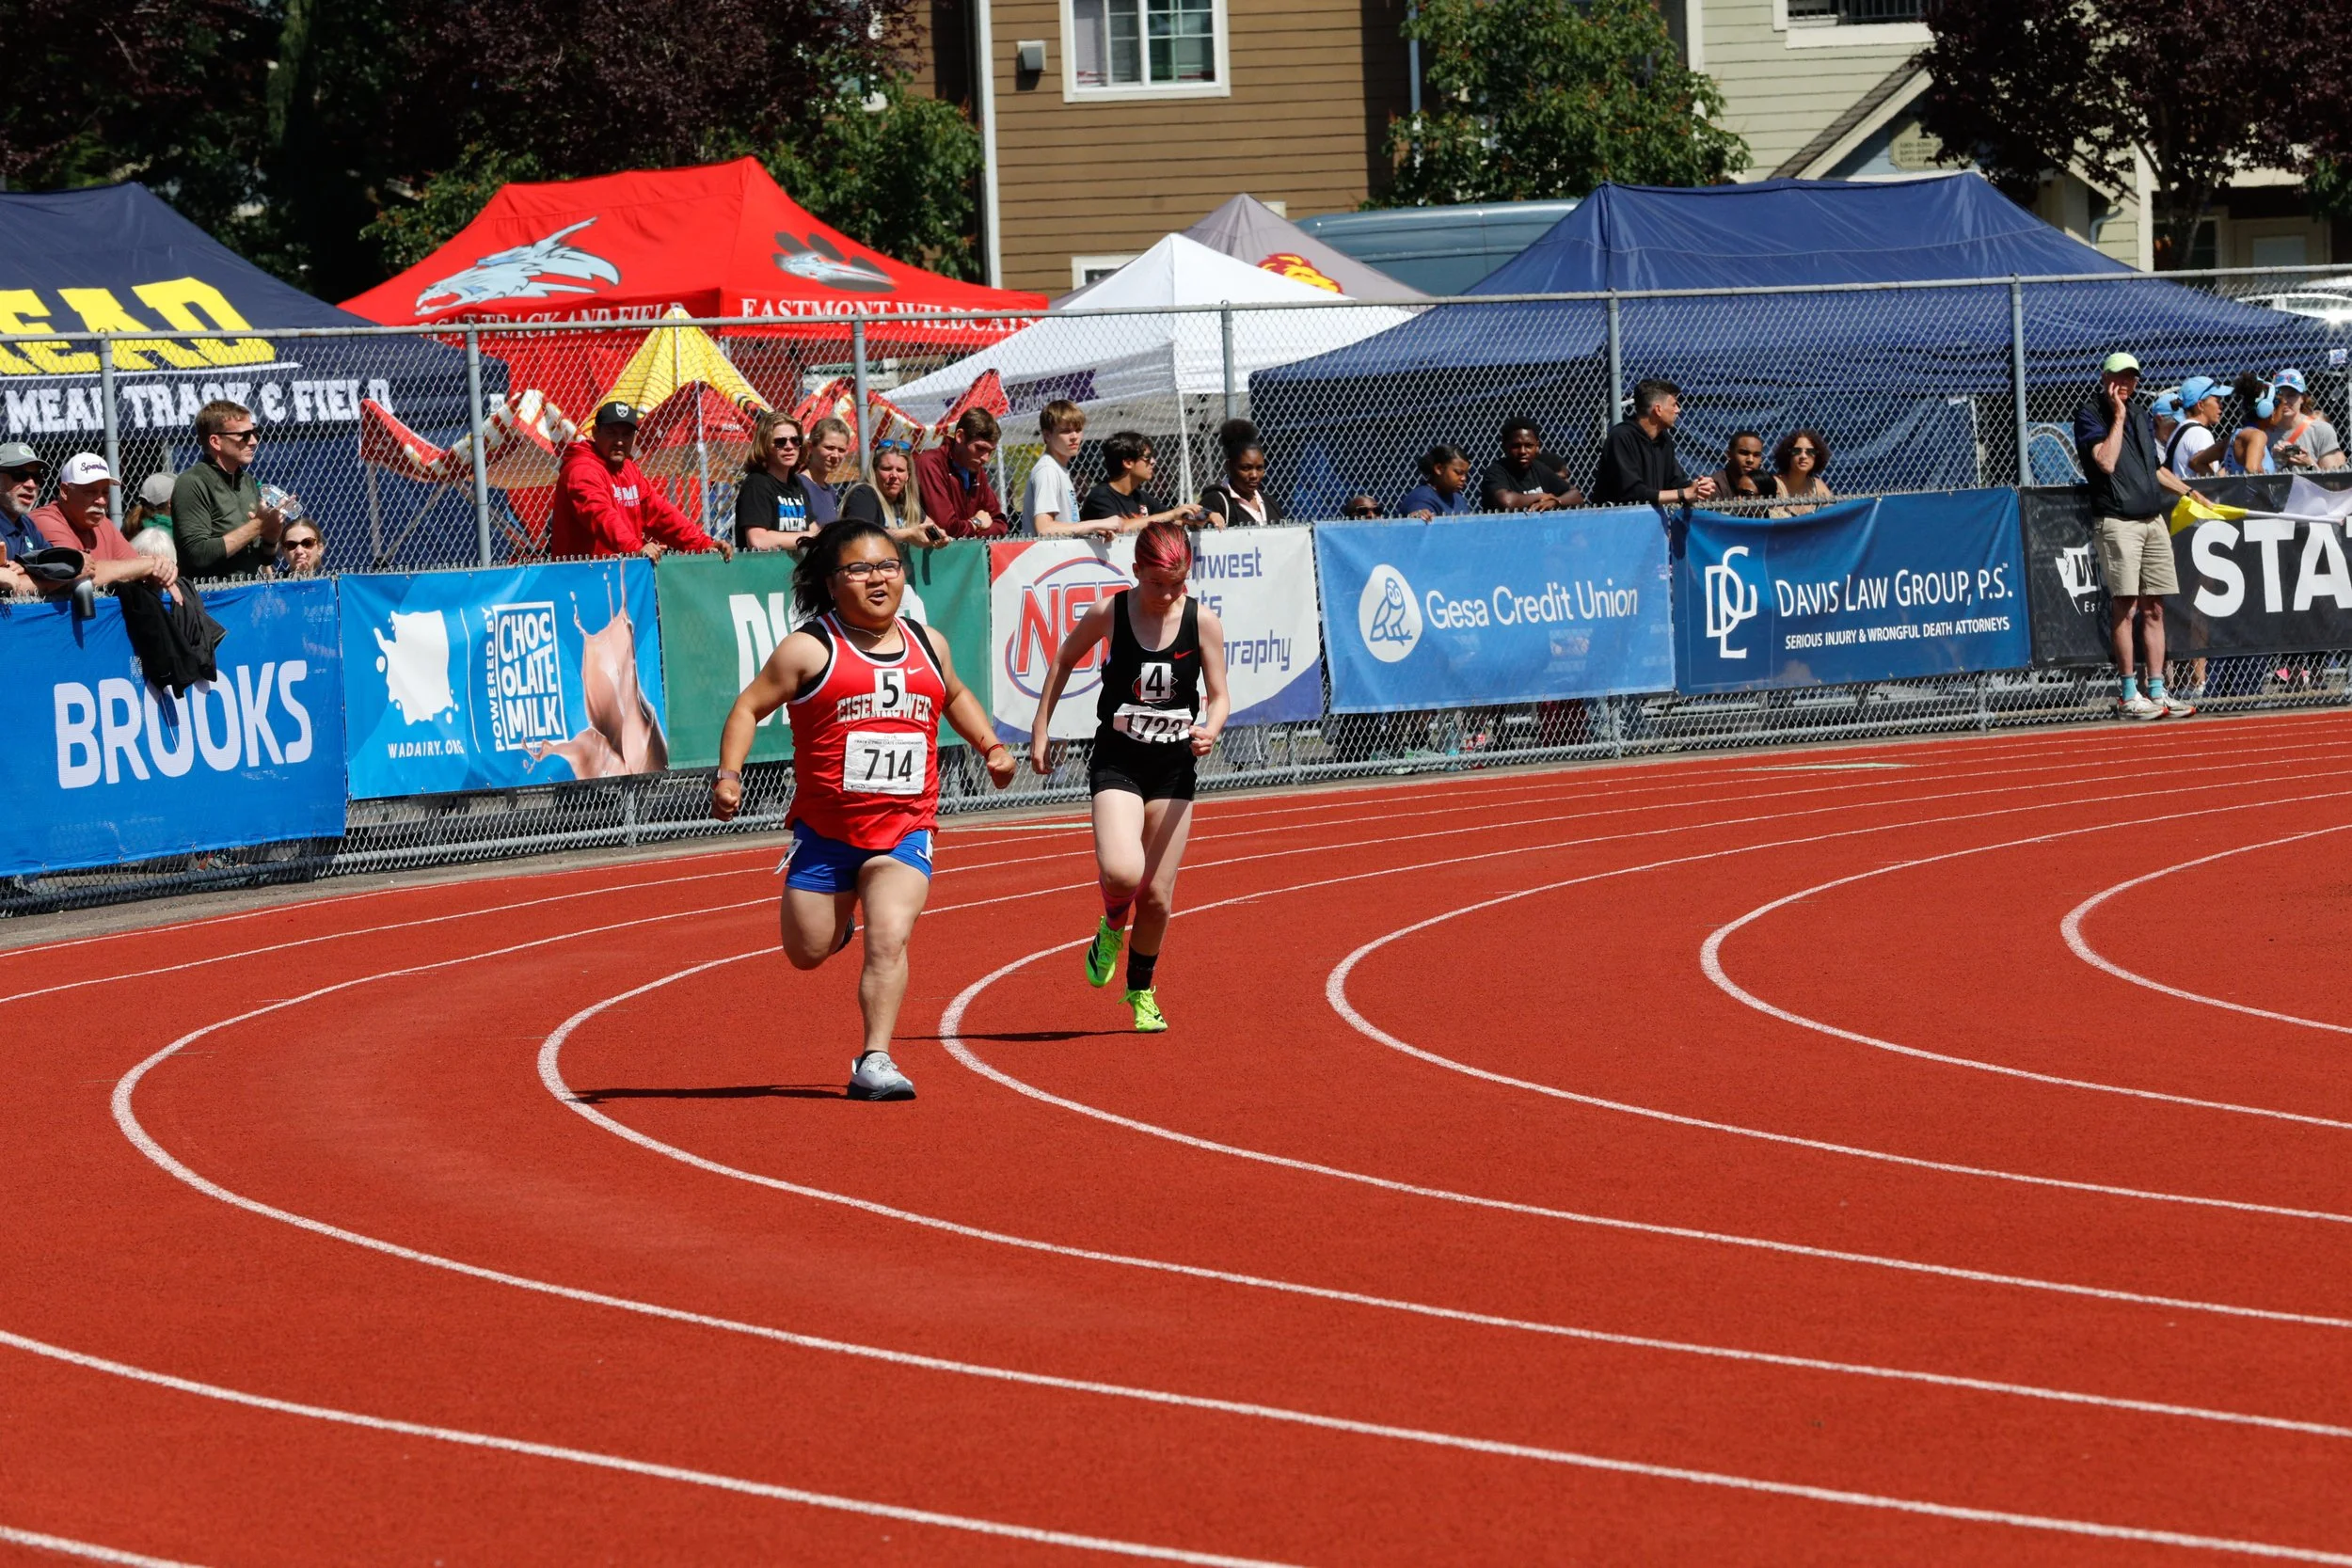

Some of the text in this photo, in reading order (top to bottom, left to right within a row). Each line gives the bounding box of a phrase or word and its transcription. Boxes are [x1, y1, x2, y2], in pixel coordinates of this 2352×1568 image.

[0, 277, 275, 374] EAD
[482, 311, 562, 340] TRACK
[564, 307, 611, 335] AND
[740, 298, 1035, 333] EASTMONT WILDCATS
[1191, 546, 1263, 579] hwest
[2191, 515, 2352, 618] STA
[1425, 578, 1637, 629] Gesa Credit Union
[1775, 579, 1839, 617] DAVIS
[1845, 574, 1888, 611] LAW
[1895, 569, 1972, 607] GROUP,
[1978, 567, 2013, 600] P.S.
[499, 612, 552, 663] CHOC
[1785, 616, 2010, 650] SERIOUS INJURY & WRONGFUL DEATH ATTORNEYS
[482, 607, 505, 752] POWERED BY
[501, 643, 557, 697] OLATE
[882, 672, 898, 708] 5
[1145, 665, 1165, 697] 4
[54, 660, 312, 789] BROOKS
[505, 696, 563, 739] MILK
[388, 740, 466, 759] WADAIRY.ORG
[865, 749, 913, 783] 714
